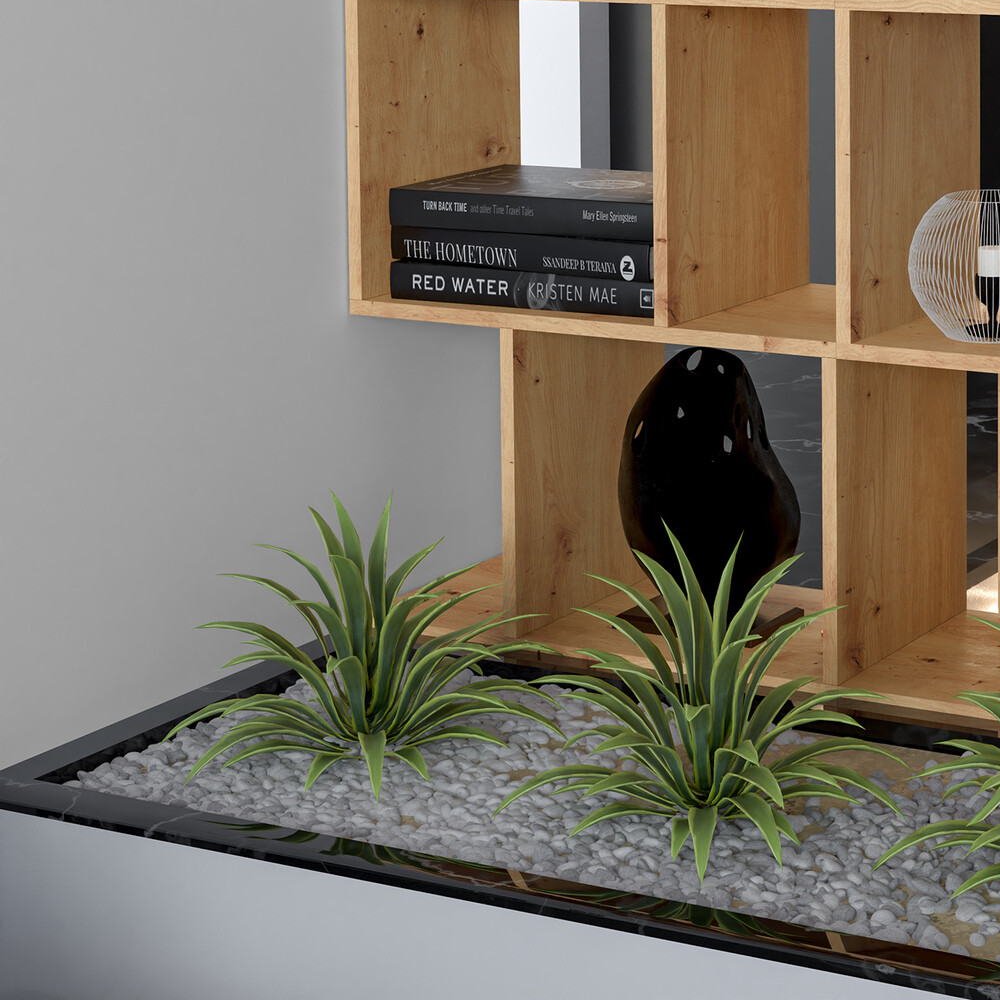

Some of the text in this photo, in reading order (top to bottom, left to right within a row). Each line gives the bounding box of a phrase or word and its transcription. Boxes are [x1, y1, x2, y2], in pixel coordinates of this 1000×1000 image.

[423, 200, 437, 210] TURN
[438, 201, 452, 211] BACK
[454, 202, 467, 212] TIME
[506, 205, 520, 215] Travel
[521, 206, 534, 216] Tales
[582, 210, 637, 224] Mary Ellen Springsteen
[404, 239, 518, 268] THE HOMETOWN
[543, 256, 616, 273] SSANDEEP B TERAIYA
[412, 274, 509, 296] RED WATER
[528, 282, 617, 304] KRISTEN MAE
